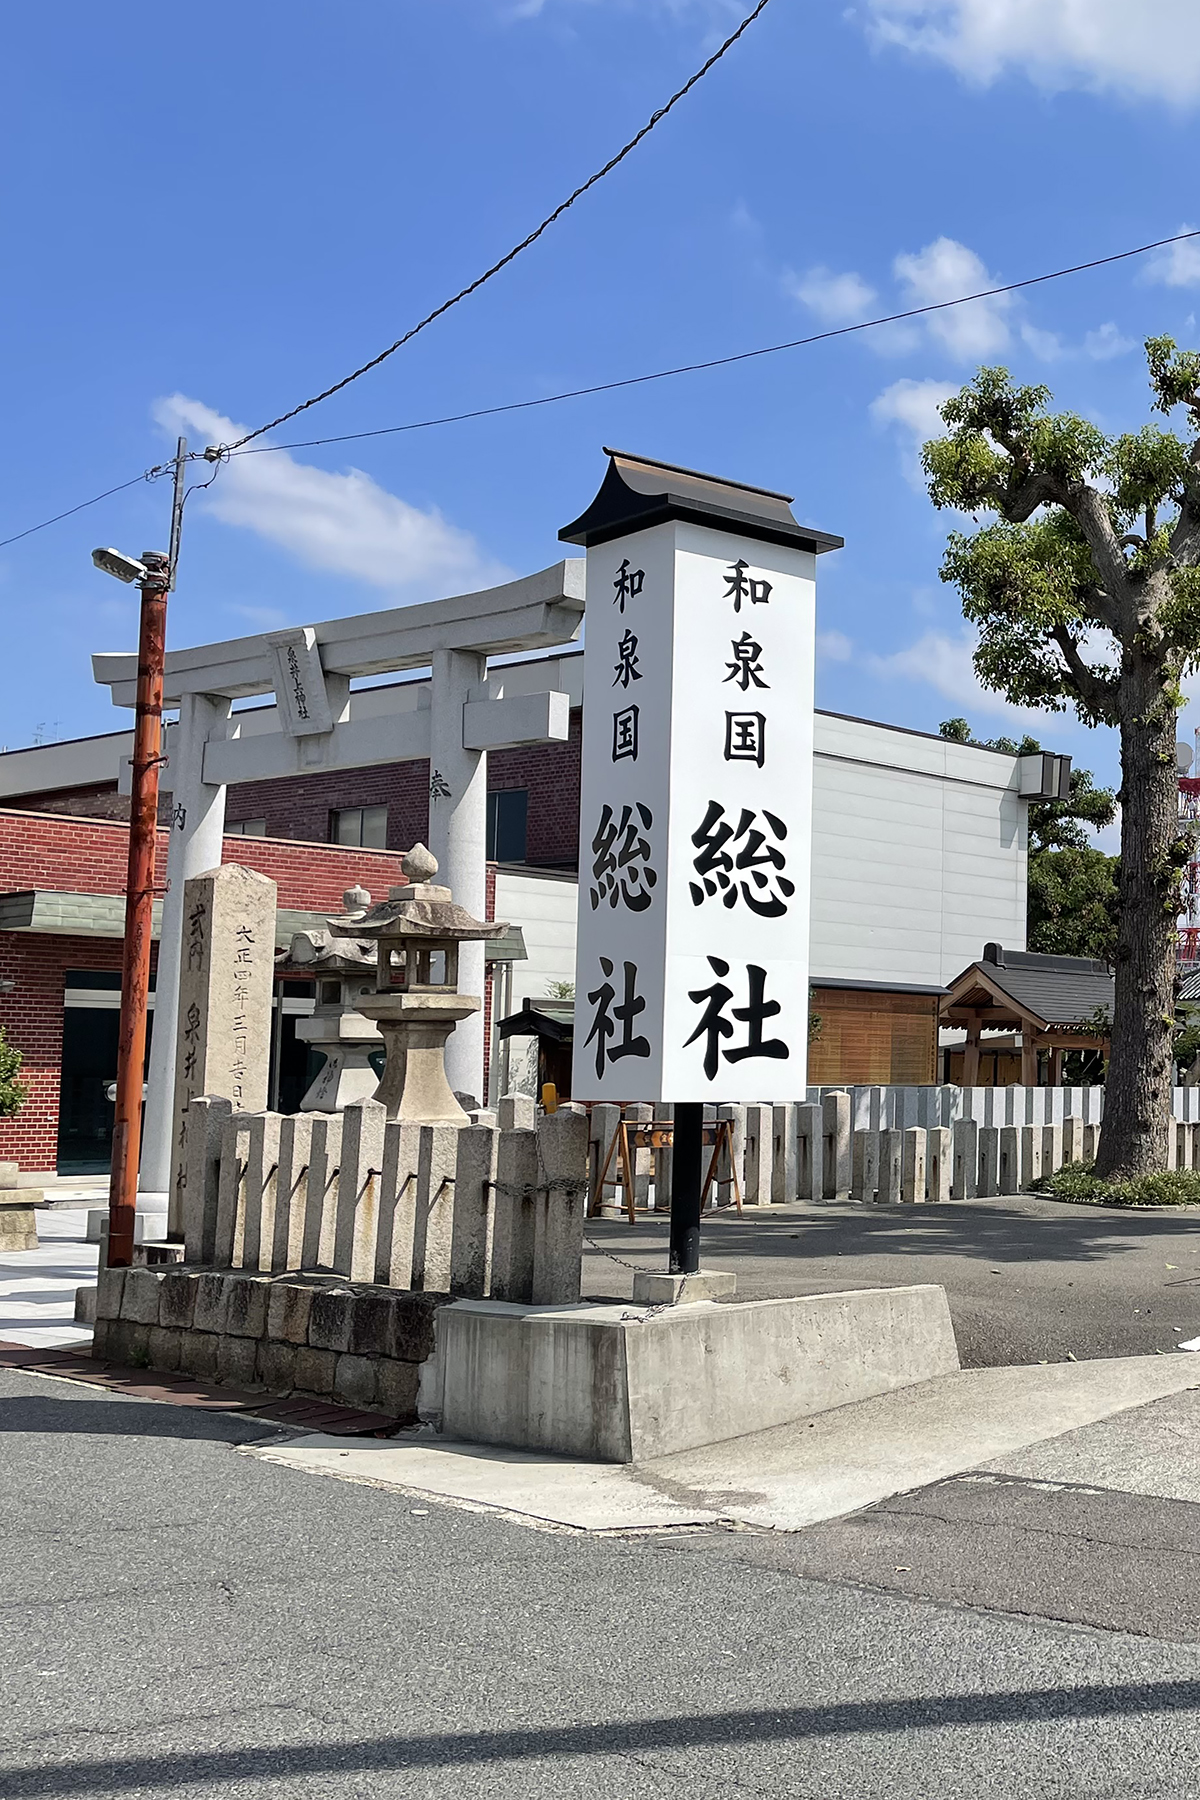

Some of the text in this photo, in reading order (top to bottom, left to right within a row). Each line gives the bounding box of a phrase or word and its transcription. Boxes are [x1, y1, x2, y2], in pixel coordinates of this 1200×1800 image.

[286, 646, 311, 720] 泉井上神社
[430, 770, 452, 802] 奉
[583, 557, 658, 1081] 和泉国総社
[682, 557, 796, 1081] 和泉国総社
